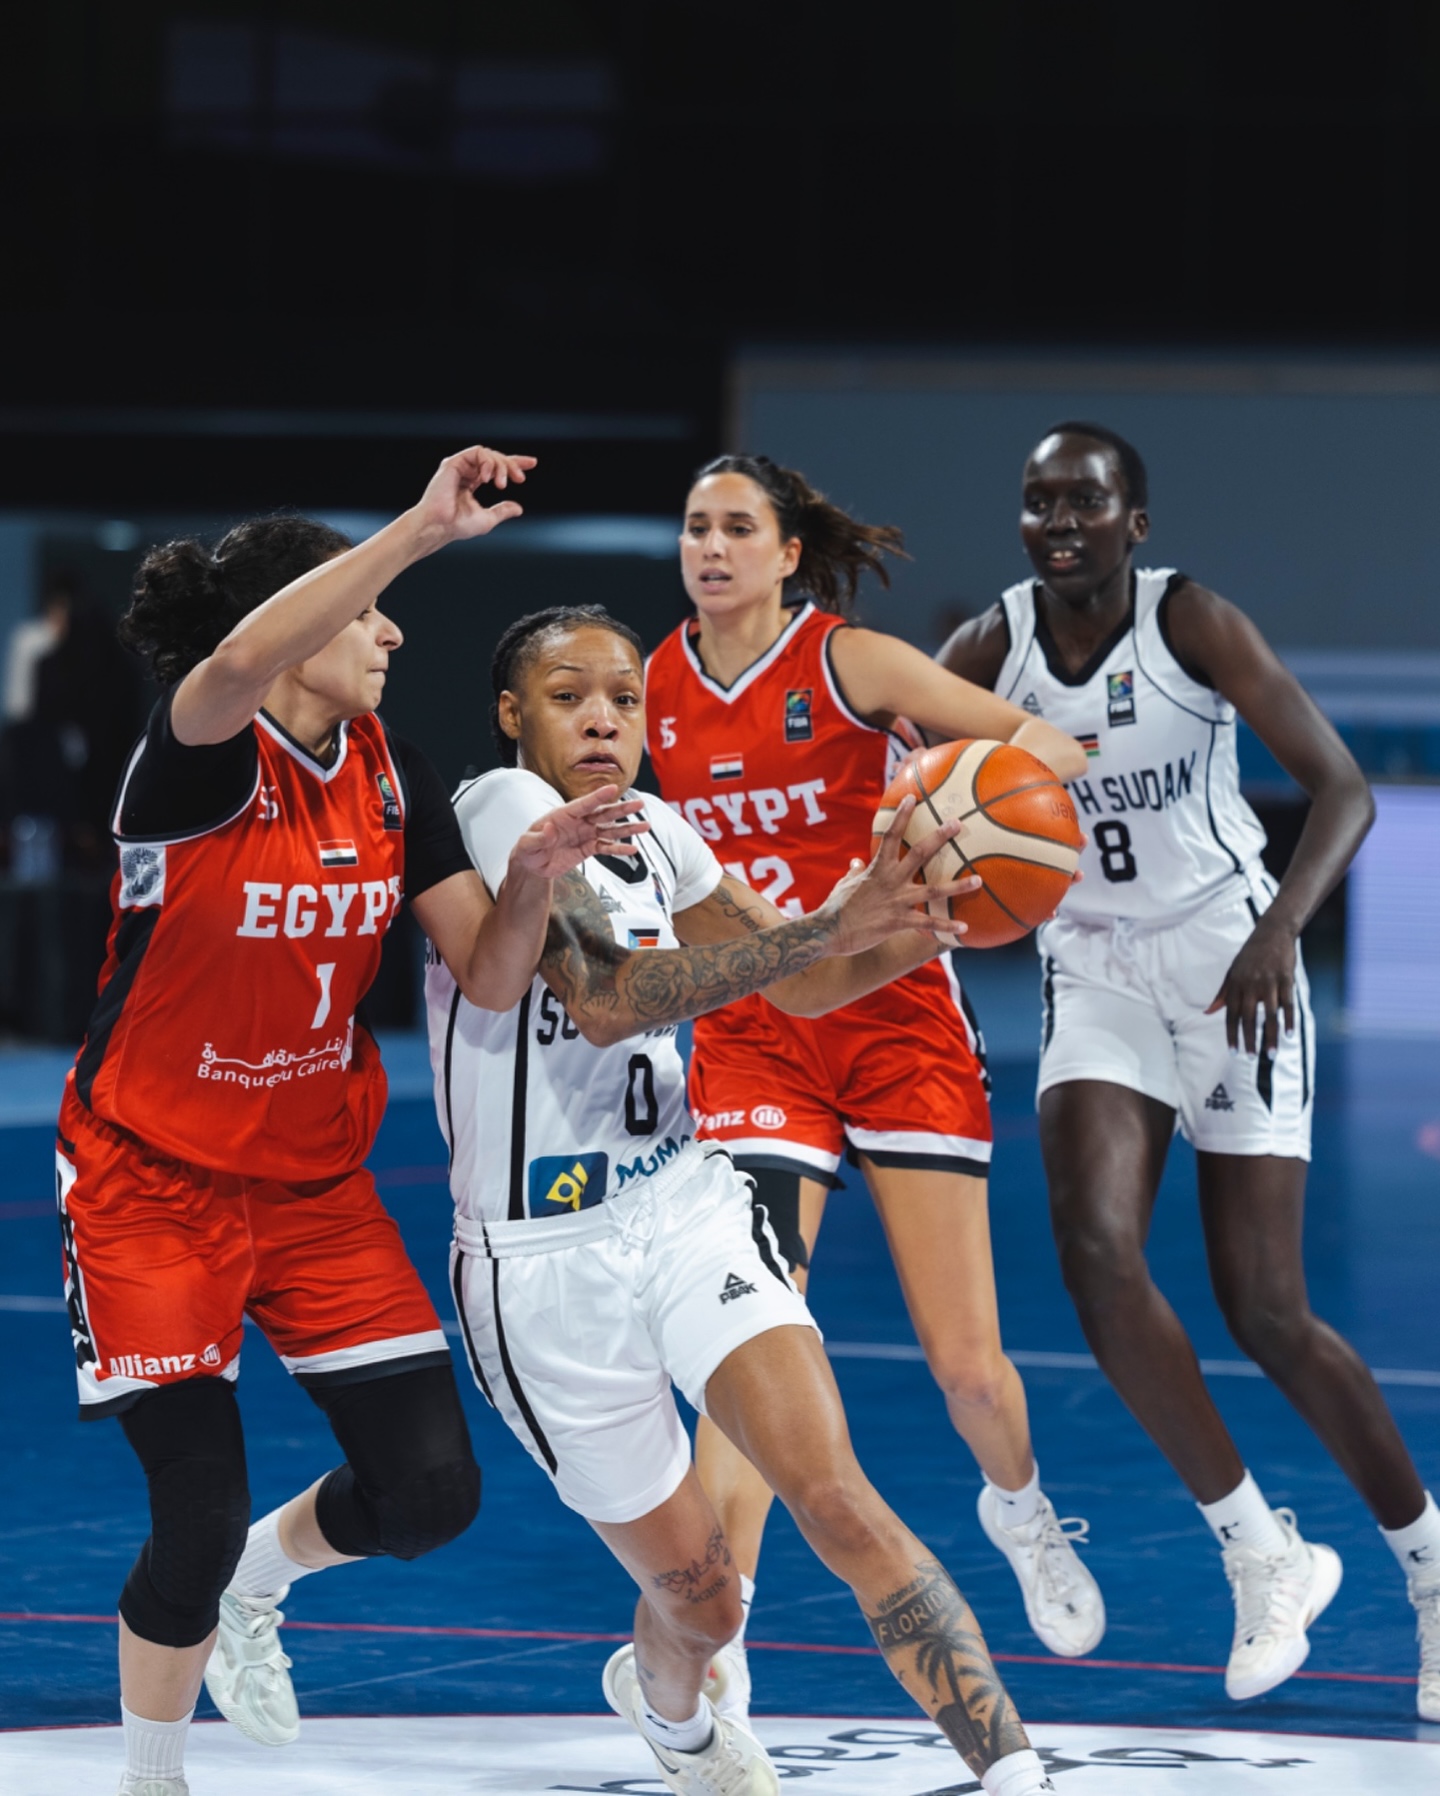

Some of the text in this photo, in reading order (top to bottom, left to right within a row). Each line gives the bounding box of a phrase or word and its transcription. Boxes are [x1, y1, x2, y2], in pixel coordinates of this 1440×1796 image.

[1101, 750, 1196, 812] SUDAN
[1092, 820, 1137, 884] 8
[310, 962, 336, 1030] 1
[197, 1063, 275, 1090] Banque
[297, 1058, 340, 1078] Caire
[625, 1053, 659, 1137] 0
[718, 1283, 760, 1305] PEAK
[109, 1353, 196, 1378] Allianz
[877, 1581, 957, 1645] FLORIDA
